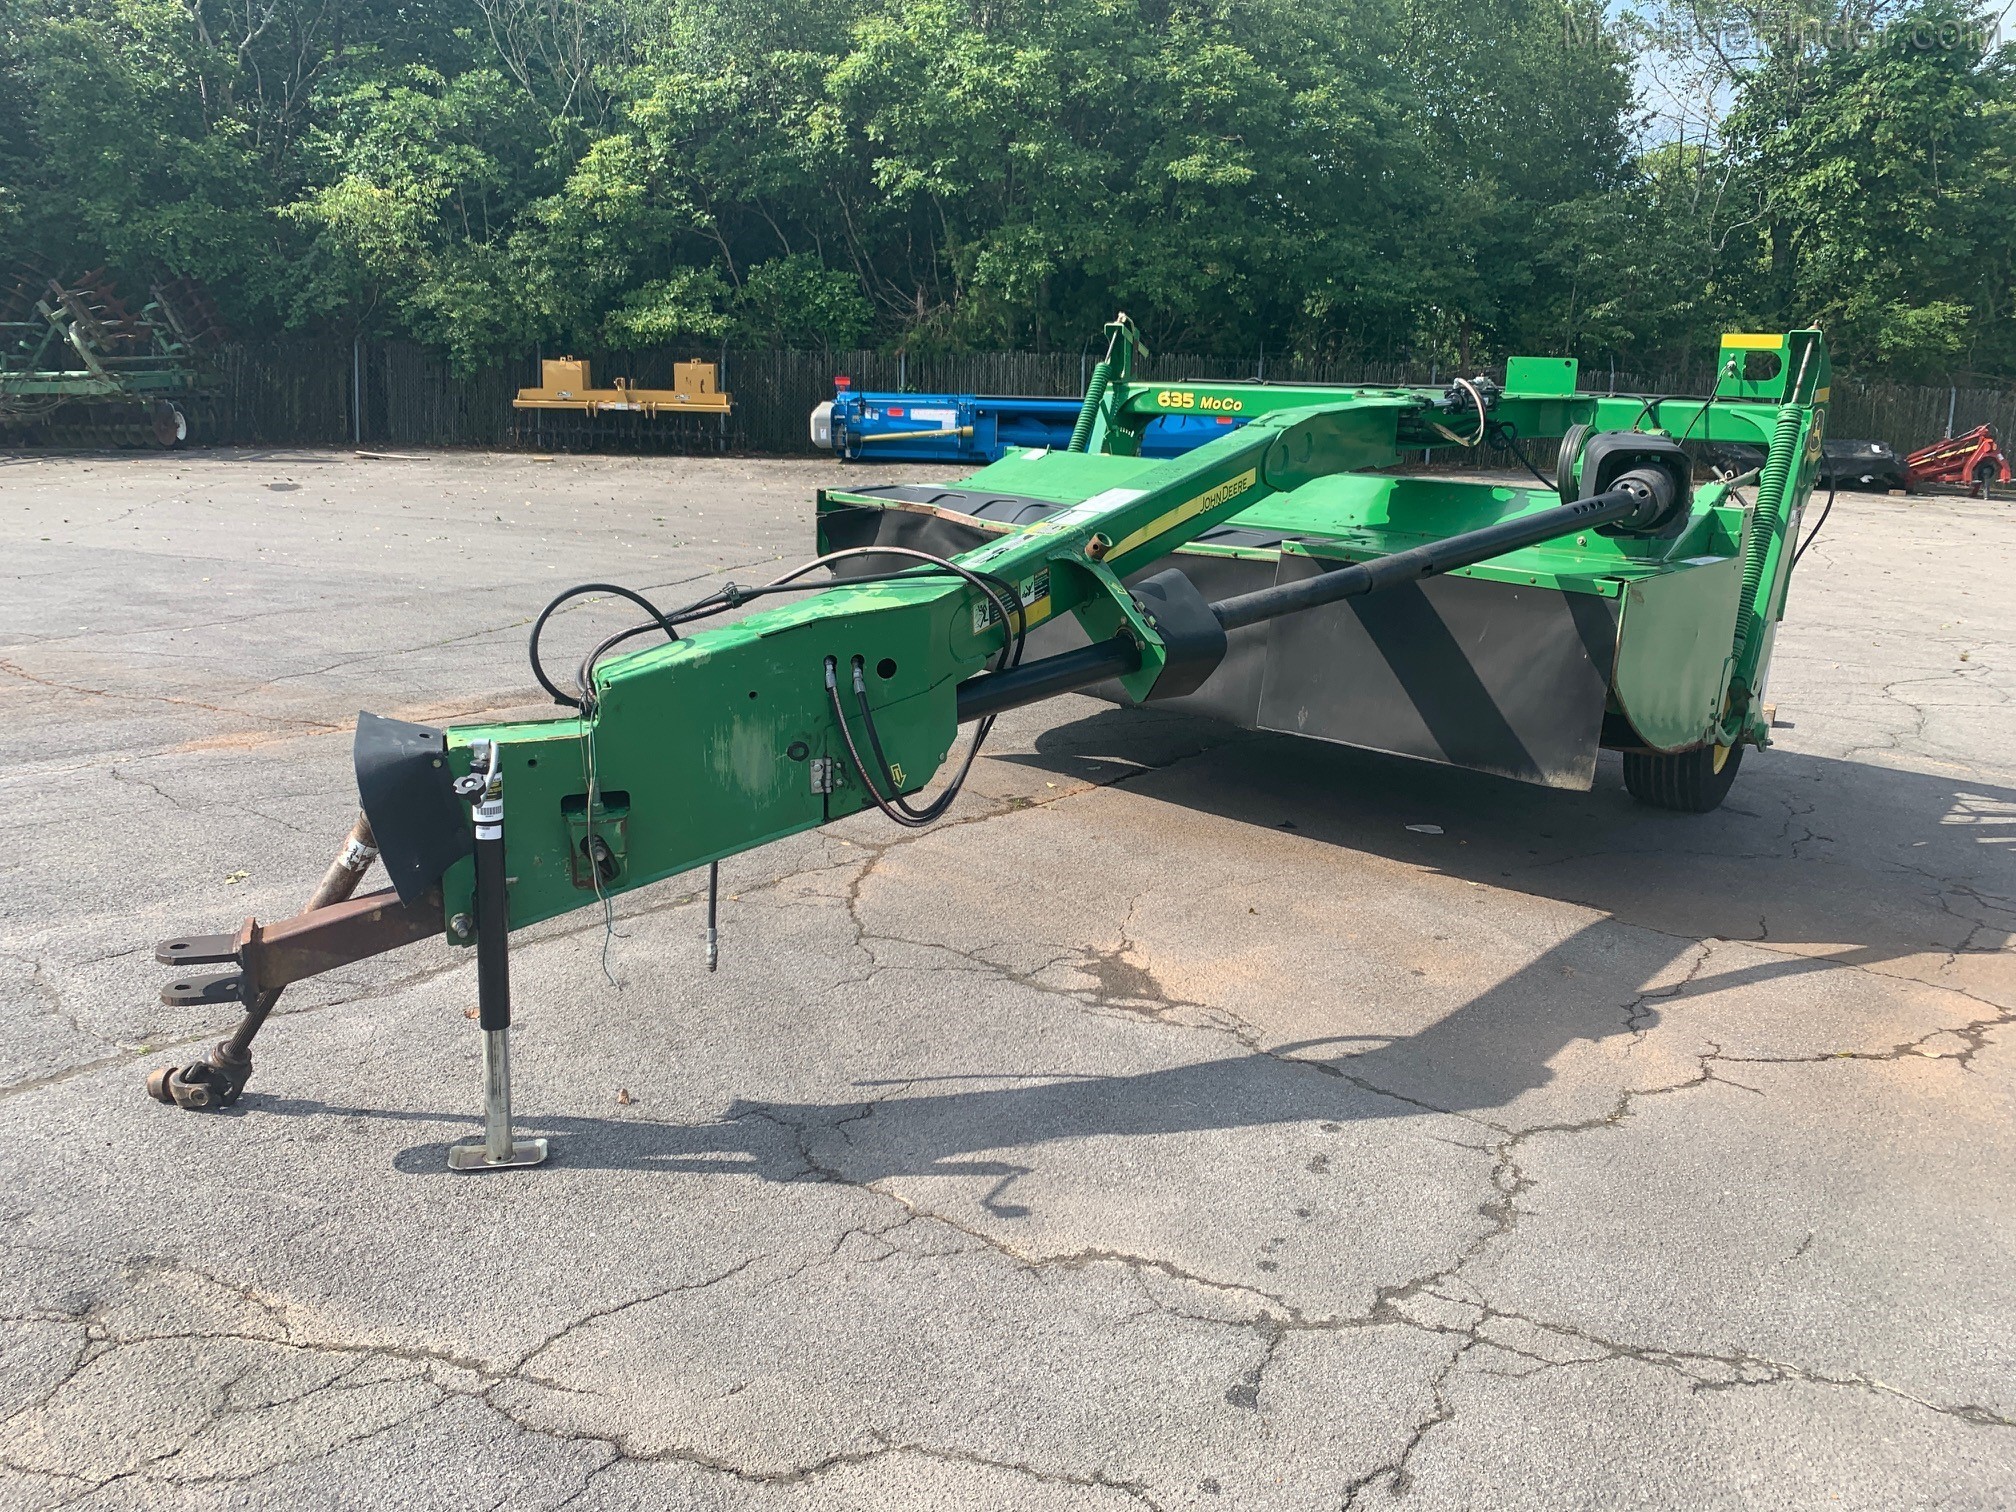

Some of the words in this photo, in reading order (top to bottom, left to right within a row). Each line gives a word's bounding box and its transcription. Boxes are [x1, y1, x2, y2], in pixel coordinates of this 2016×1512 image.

[1157, 391, 1194, 408] 635
[1200, 397, 1242, 411] MoCo
[1200, 492, 1222, 513] JOHN
[1222, 478, 1247, 500] DEERE
